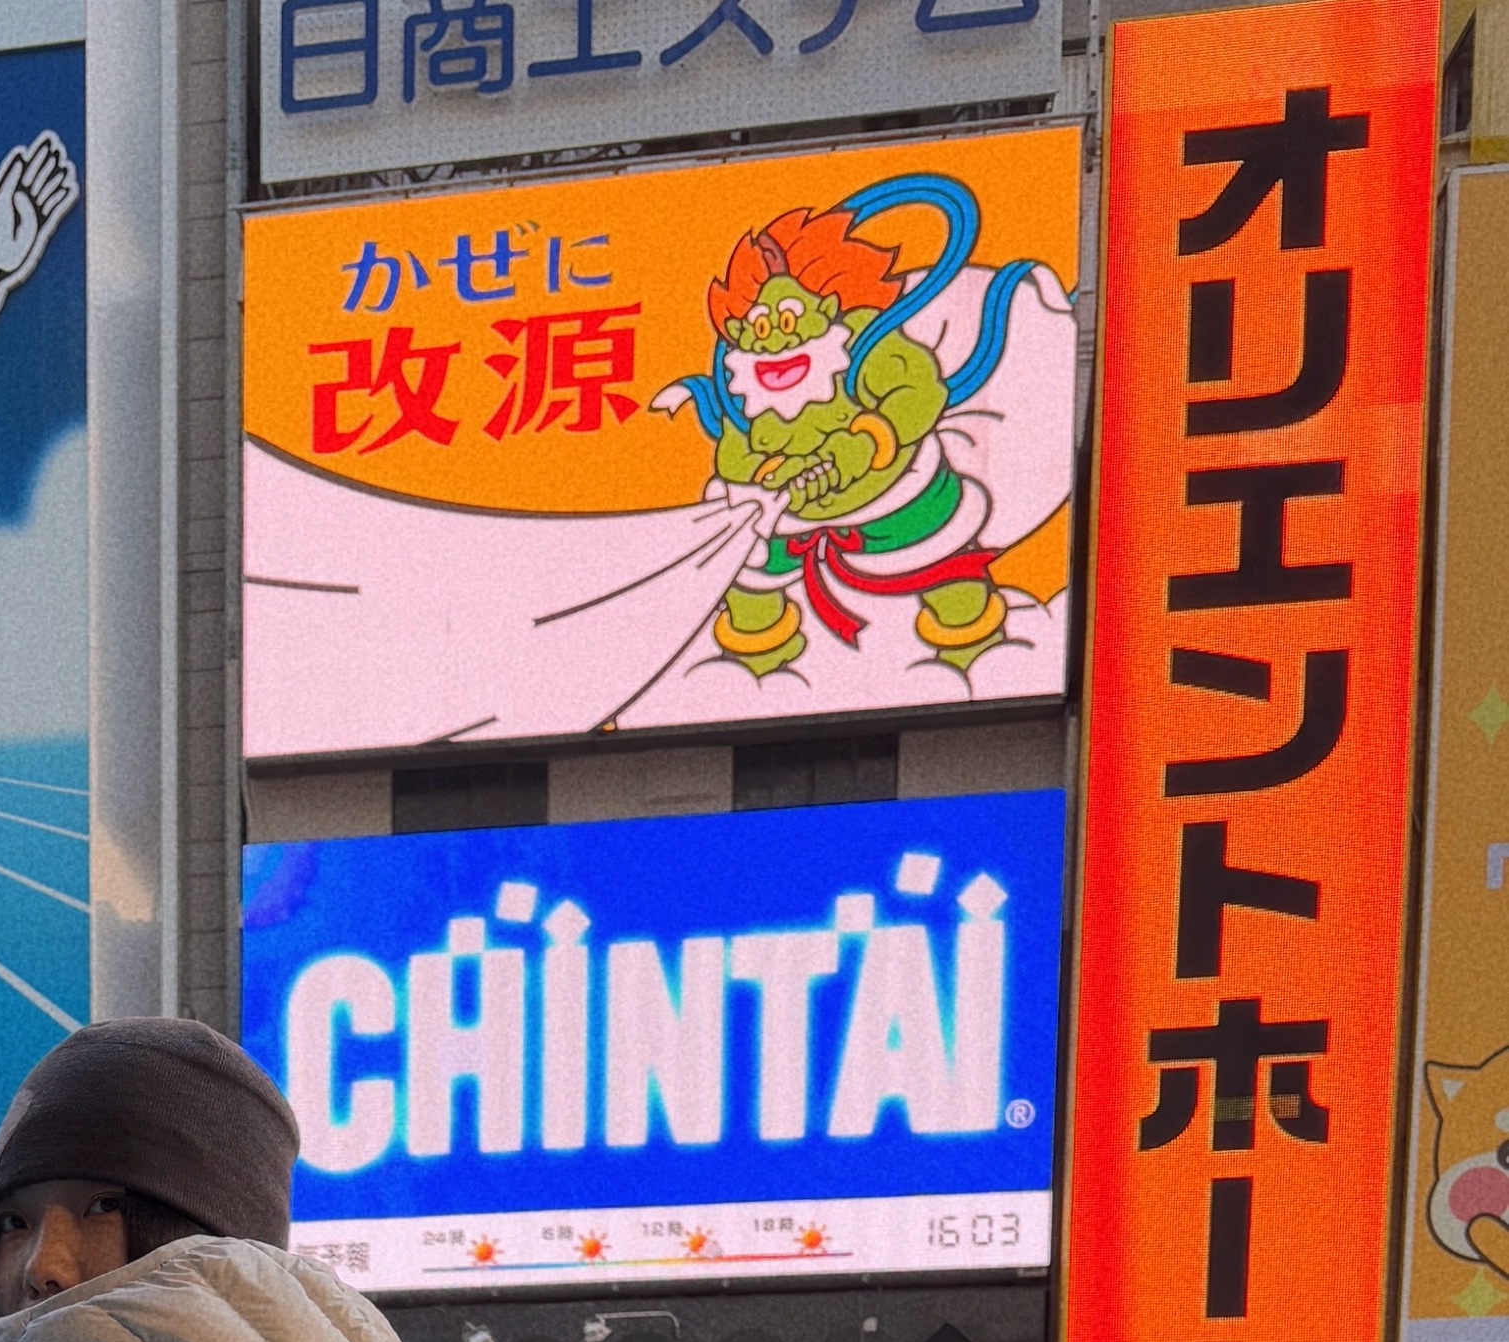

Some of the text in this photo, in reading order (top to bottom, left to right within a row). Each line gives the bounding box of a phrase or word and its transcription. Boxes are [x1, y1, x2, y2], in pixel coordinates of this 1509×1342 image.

[341, 220, 613, 313] かぜに
[309, 302, 643, 456] 改源
